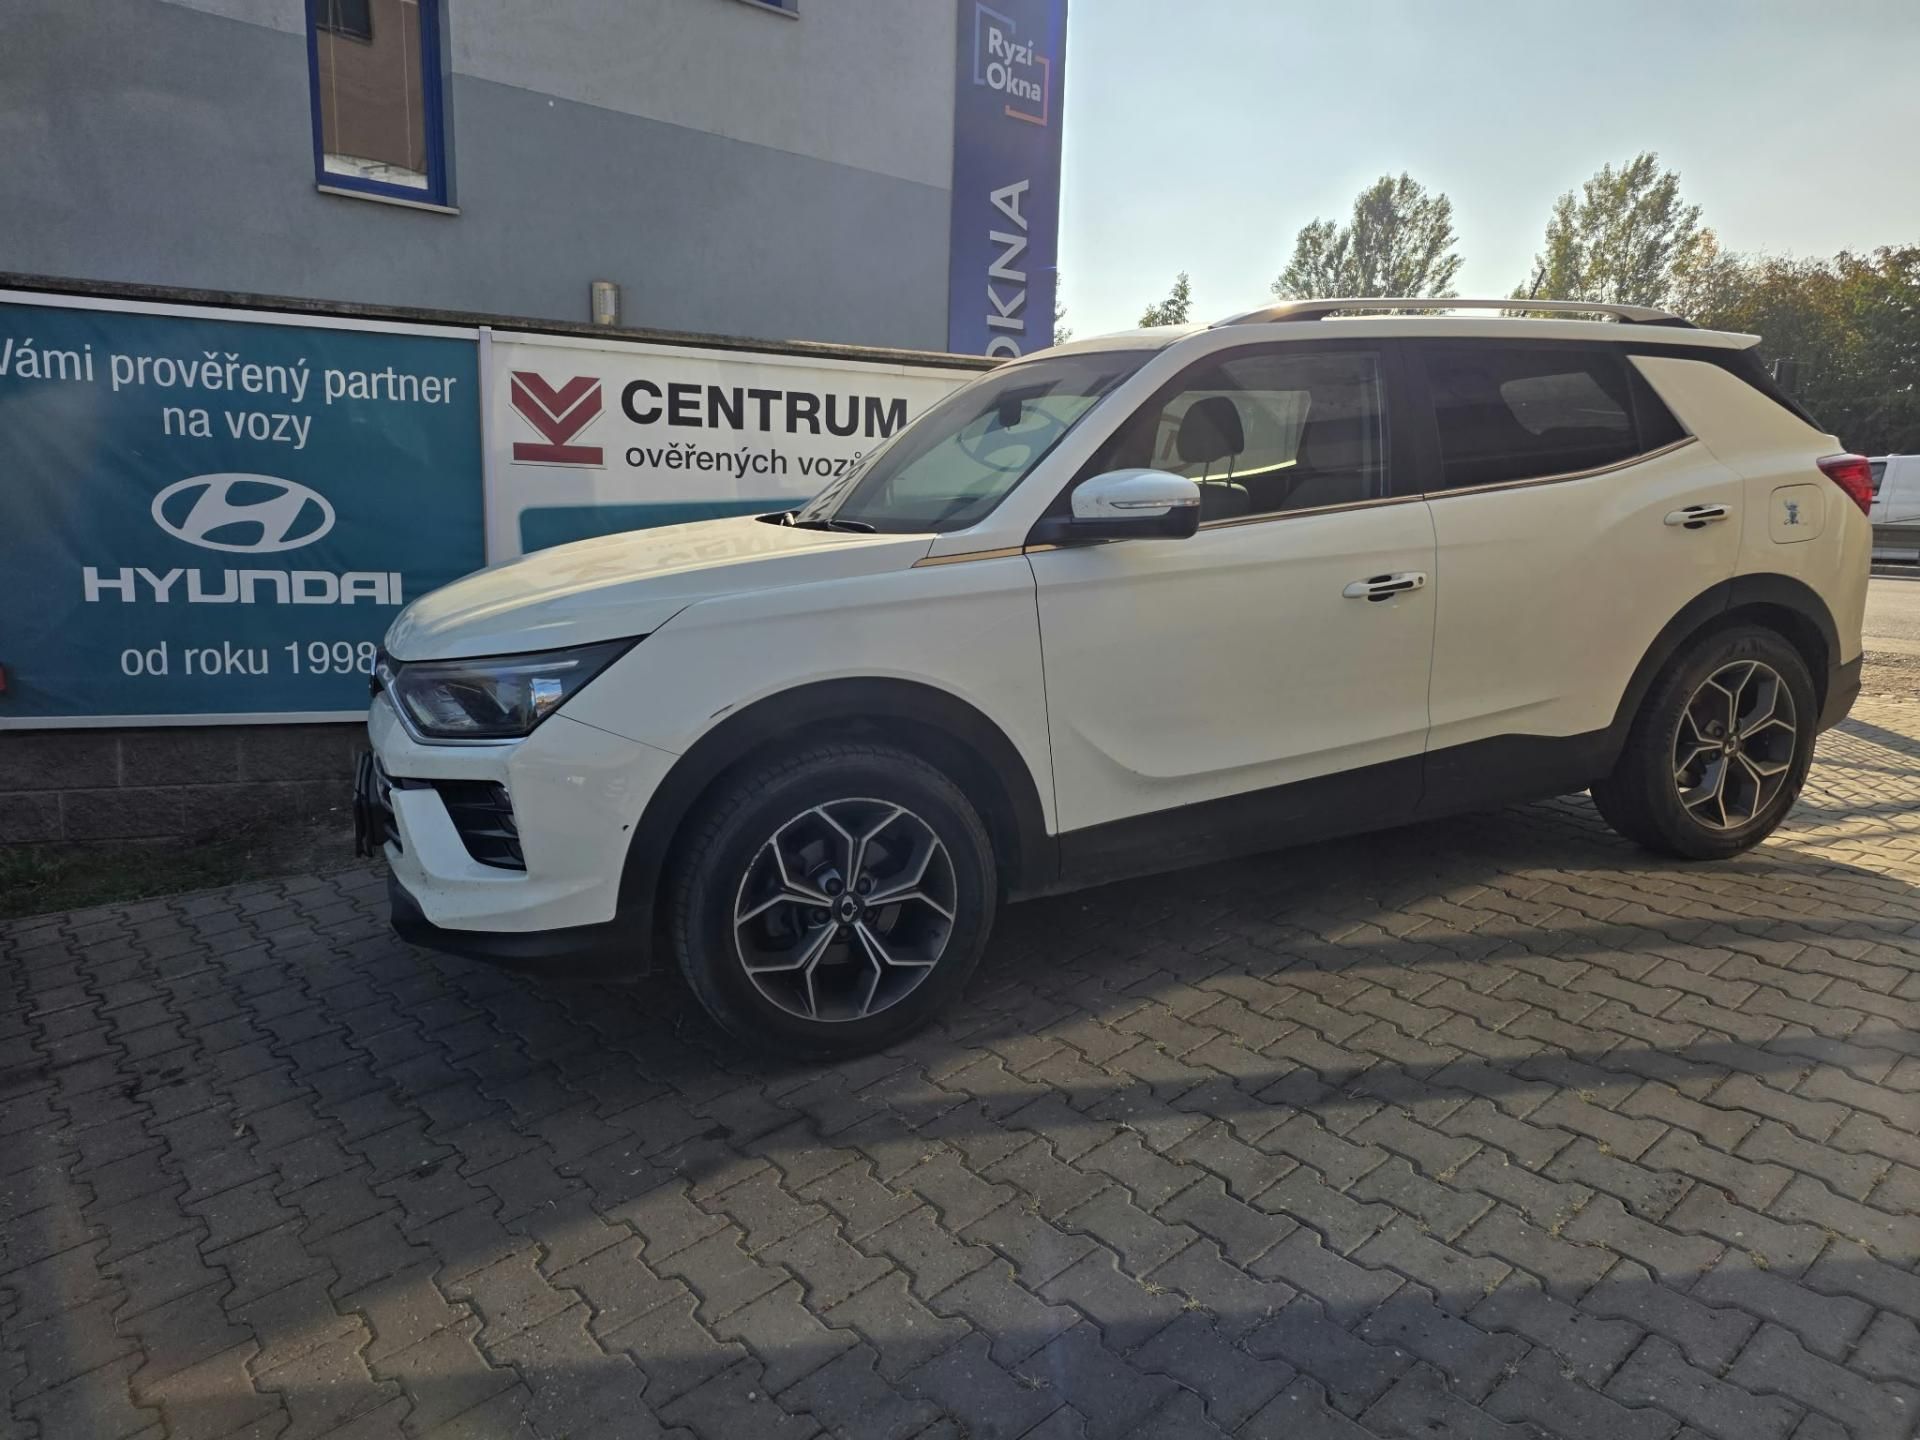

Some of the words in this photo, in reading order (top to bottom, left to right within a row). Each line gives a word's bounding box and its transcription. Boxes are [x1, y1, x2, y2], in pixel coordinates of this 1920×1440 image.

[988, 27, 1033, 67] Ryzí
[986, 62, 1041, 102] Okna
[111, 351, 310, 402] prověřený
[325, 365, 457, 404] partner
[163, 406, 212, 438] na
[225, 411, 312, 449] vozy
[621, 379, 907, 438] CENTRUM
[625, 443, 787, 478] ověřených
[83, 566, 402, 605] HYUNDAI
[121, 641, 168, 675] od
[184, 641, 269, 675] roku
[284, 641, 375, 674] 1998
